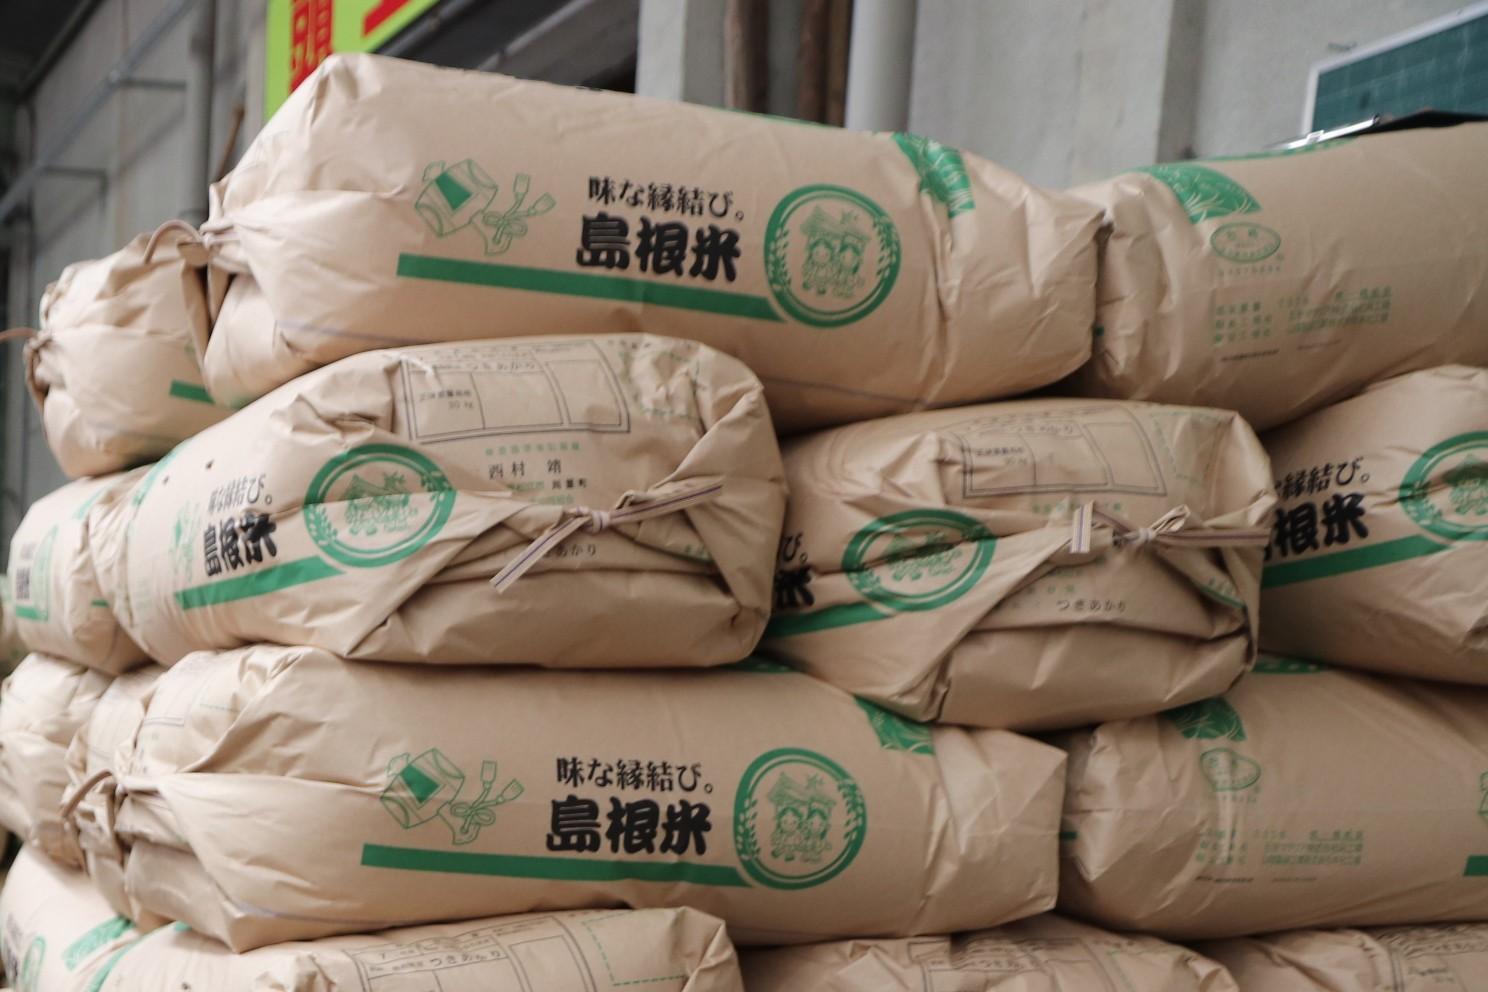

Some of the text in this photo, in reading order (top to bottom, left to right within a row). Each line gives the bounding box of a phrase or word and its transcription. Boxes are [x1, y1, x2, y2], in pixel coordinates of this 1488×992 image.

[589, 175, 745, 224] 味な縁結び。
[576, 211, 742, 283] 島根米
[556, 756, 715, 795] 味な縁結び。
[546, 795, 714, 856] 島根米
